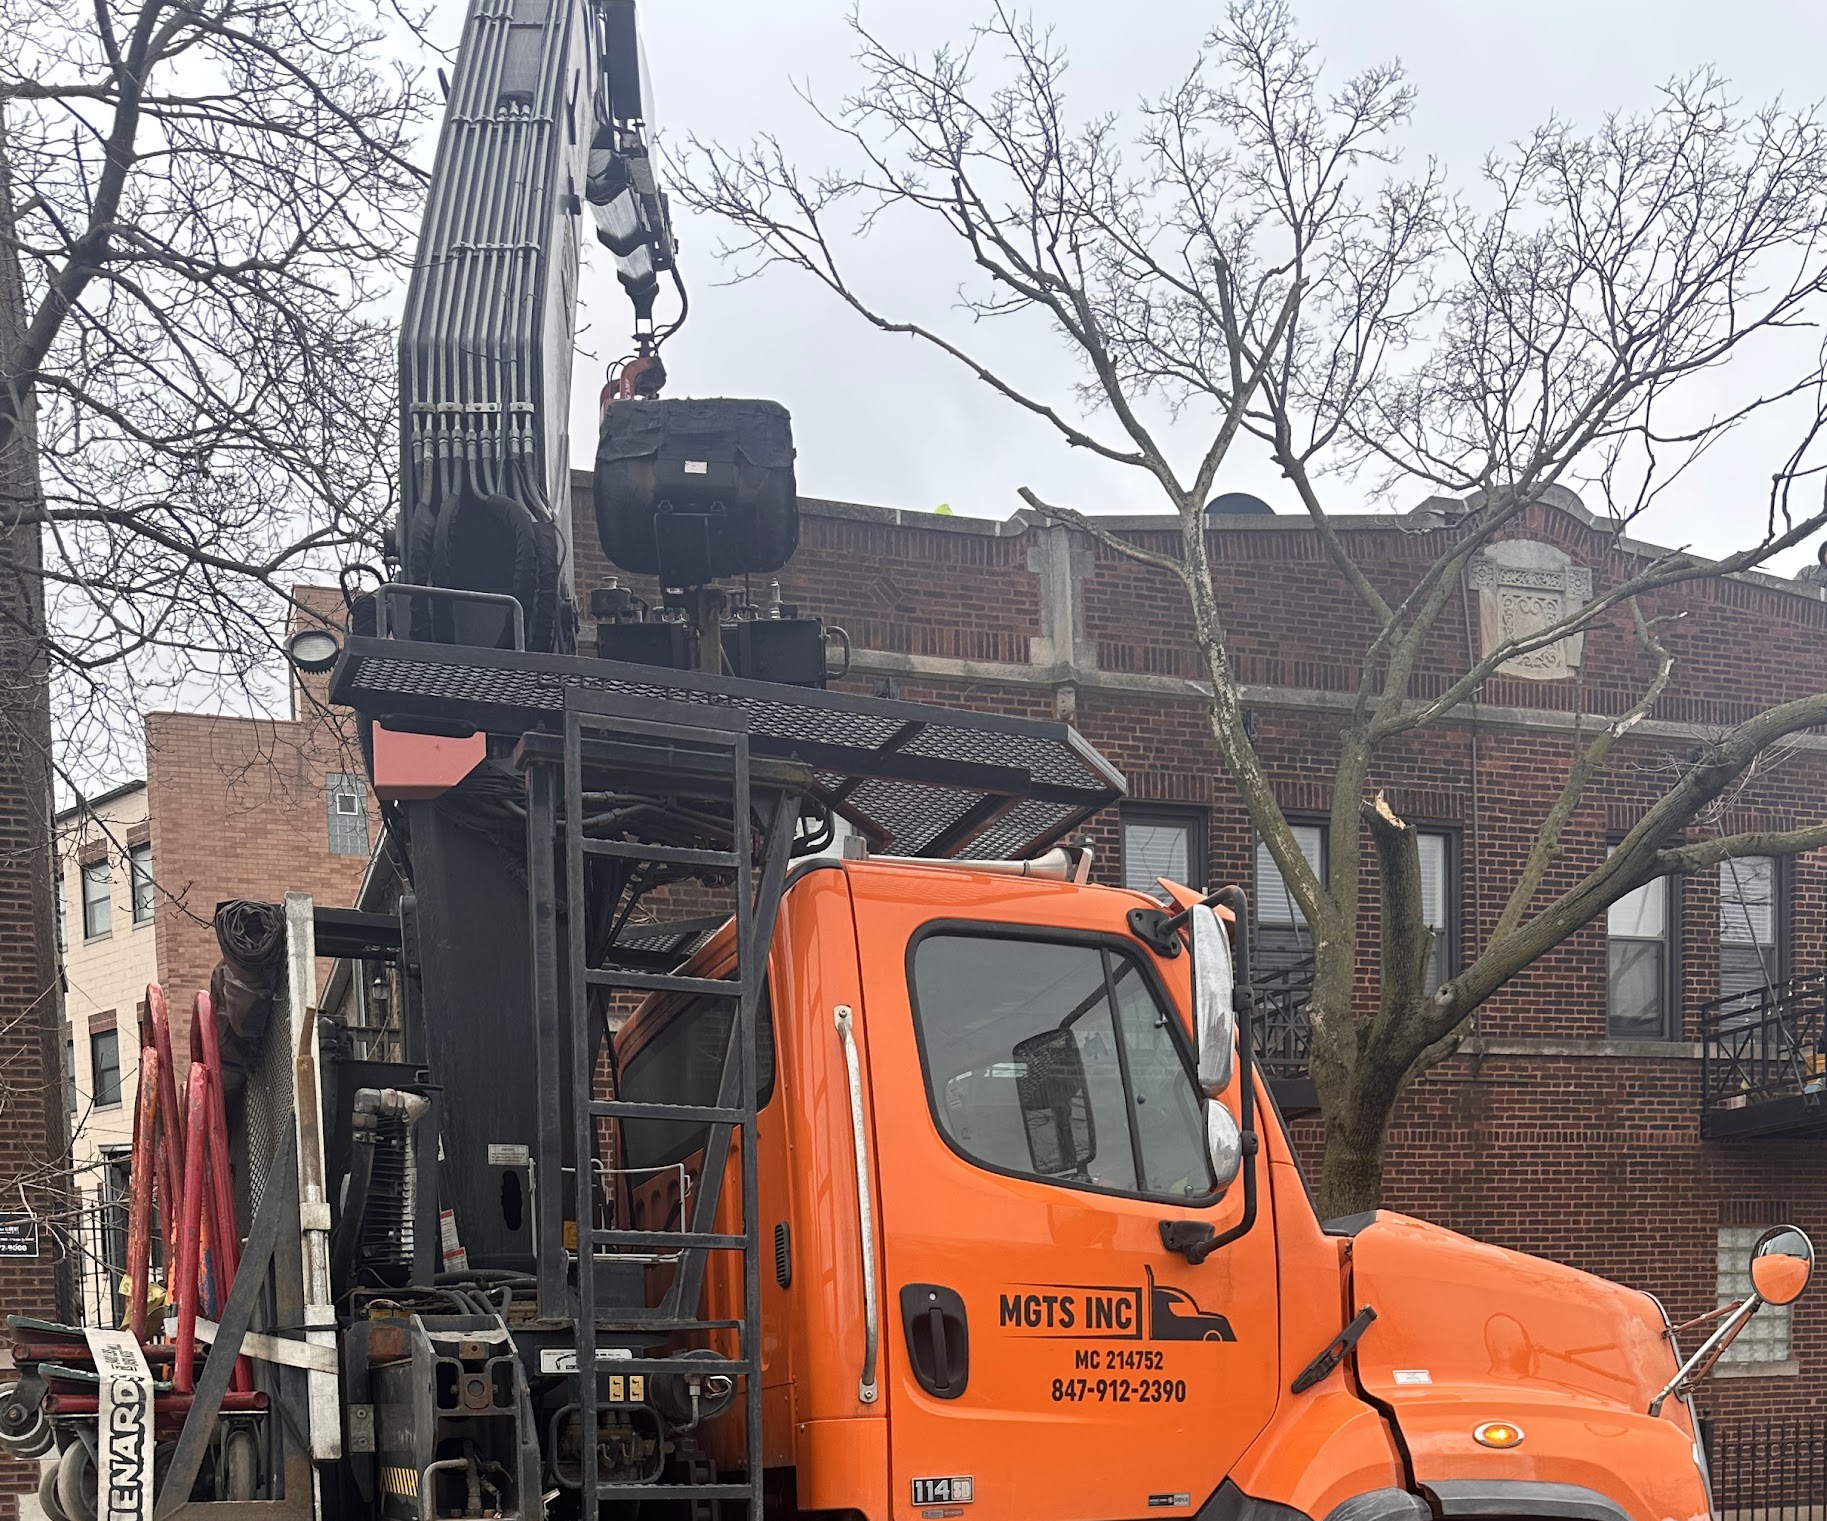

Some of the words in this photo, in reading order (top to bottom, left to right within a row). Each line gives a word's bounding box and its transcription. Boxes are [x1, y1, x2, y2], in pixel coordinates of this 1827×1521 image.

[1000, 1294, 1075, 1329] MGTS
[1086, 1296, 1132, 1330] INC
[1075, 1349, 1100, 1370] MC
[1106, 1350, 1164, 1370] 214752
[1051, 1378, 1186, 1403] 847-912-2390
